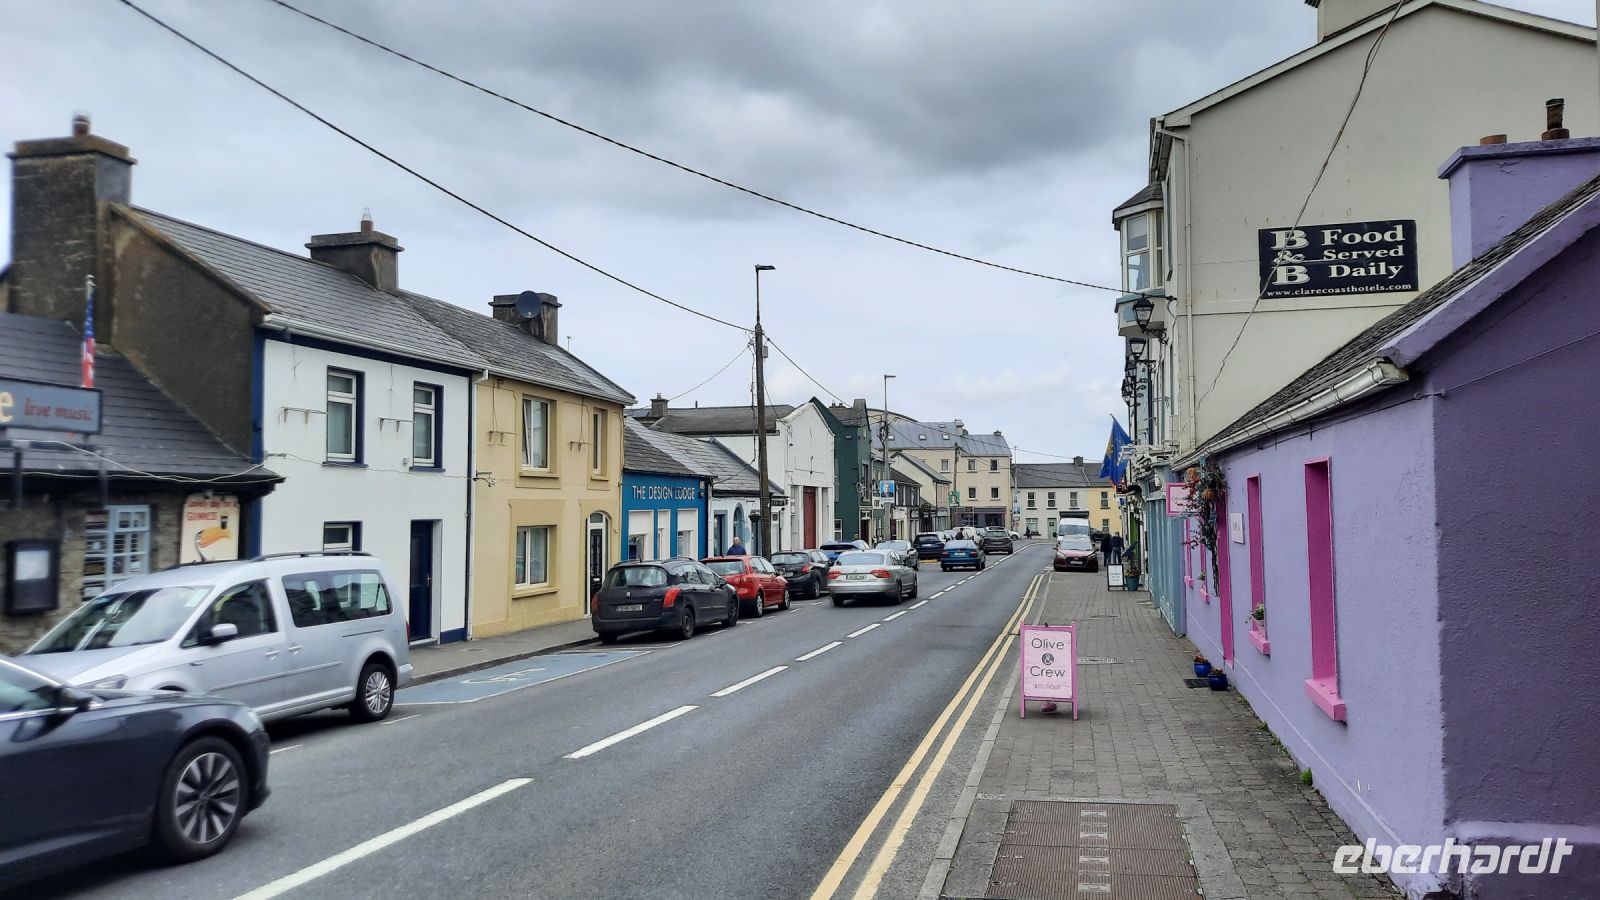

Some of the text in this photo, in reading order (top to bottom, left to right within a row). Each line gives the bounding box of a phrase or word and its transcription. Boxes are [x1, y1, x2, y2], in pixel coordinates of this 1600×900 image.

[1270, 229, 1309, 250] B
[1321, 224, 1406, 247] Food
[1273, 250, 1306, 265] &
[1323, 245, 1405, 262] Served
[1271, 265, 1311, 286] B
[1328, 262, 1404, 279] Daily
[1267, 283, 1412, 297] www.clarecoasthotels.com
[24, 397, 93, 421] live music
[632, 485, 696, 500] THE DESIGN LODGE
[1031, 637, 1065, 650] Olive
[1042, 652, 1055, 666] &
[1030, 665, 1066, 678] Crew
